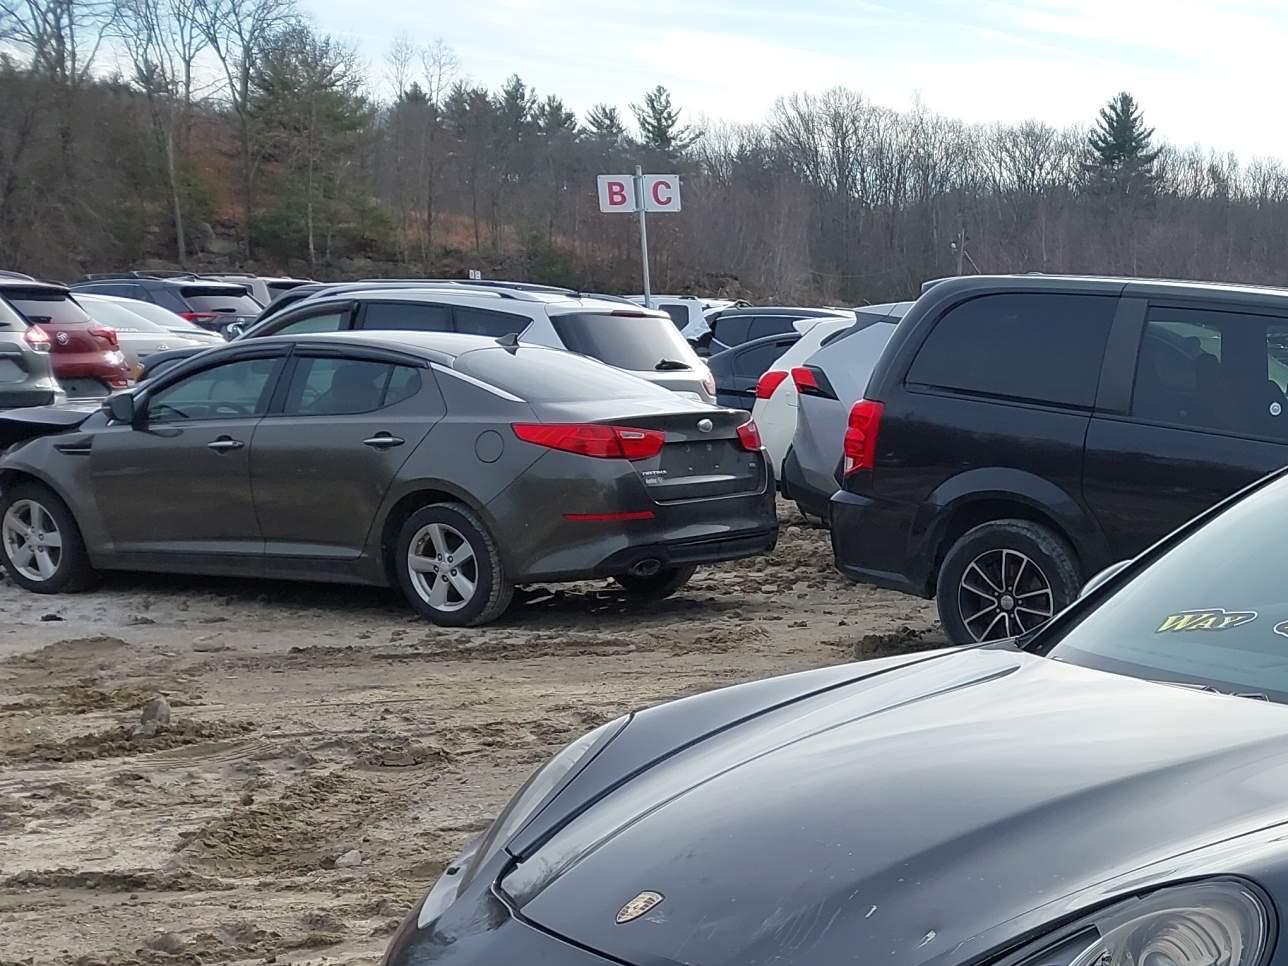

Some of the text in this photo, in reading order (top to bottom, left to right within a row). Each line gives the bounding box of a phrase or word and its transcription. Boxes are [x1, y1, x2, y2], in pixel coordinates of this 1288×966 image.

[607, 181, 627, 206] B
[652, 180, 672, 206] C
[1155, 612, 1246, 634] WAY
